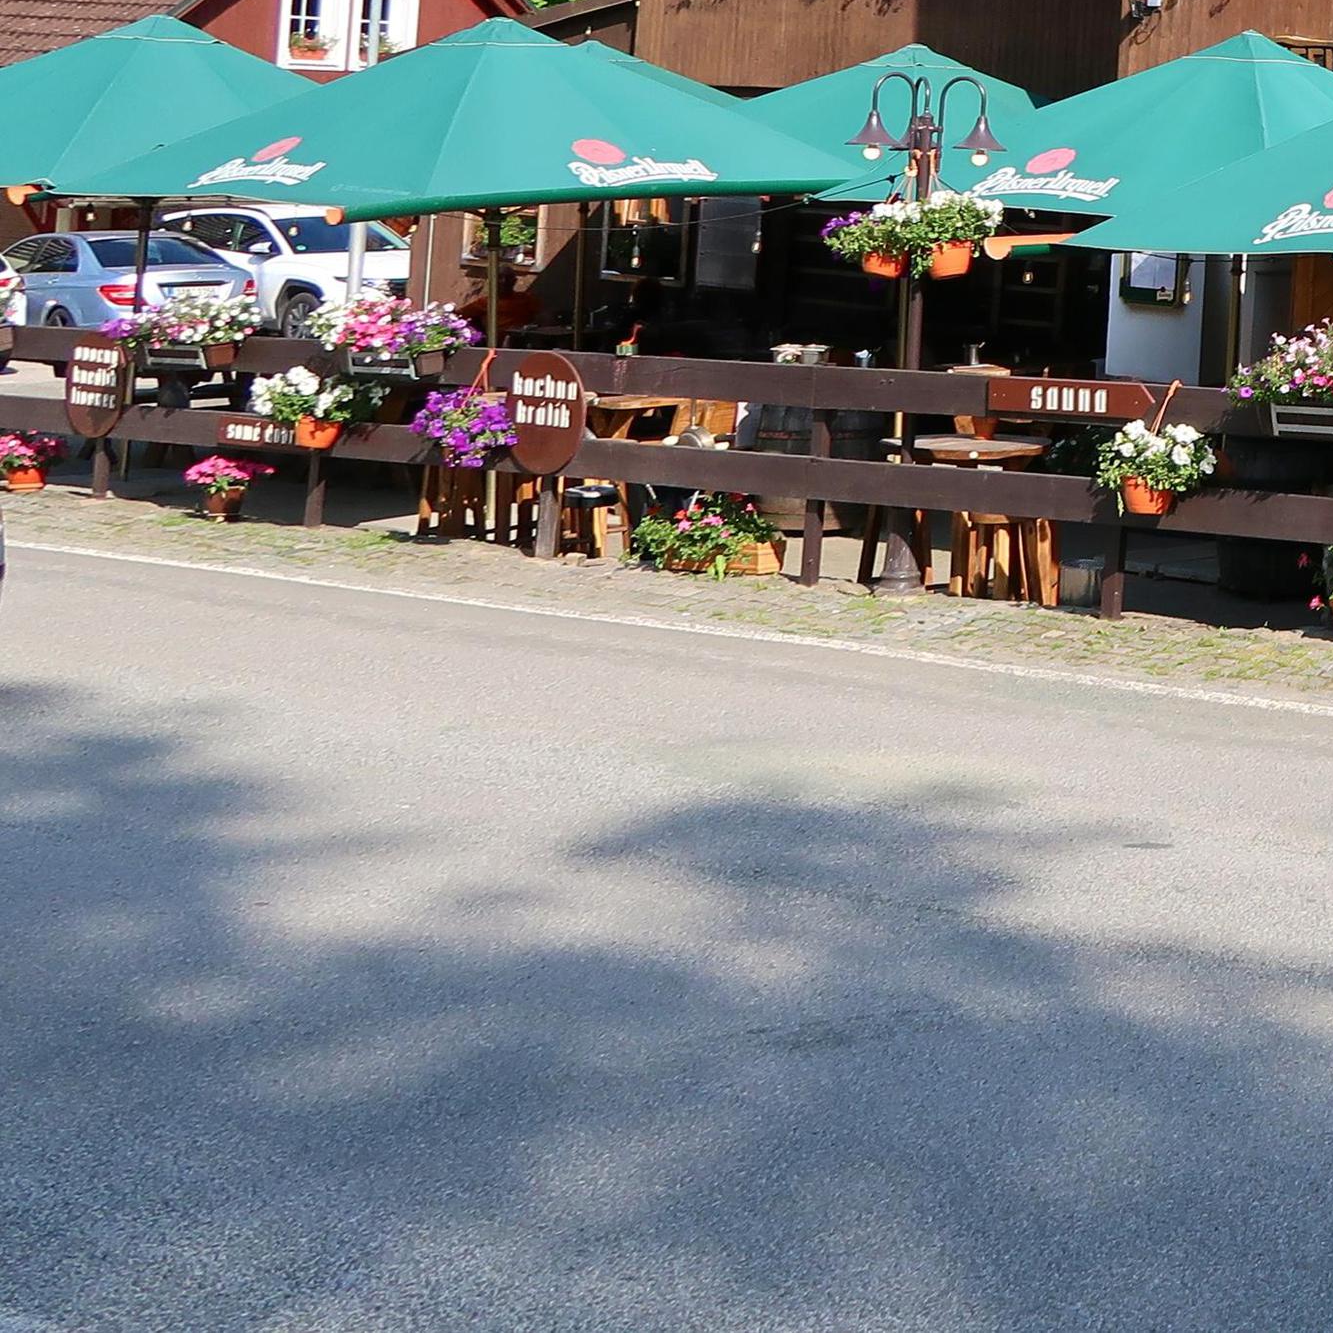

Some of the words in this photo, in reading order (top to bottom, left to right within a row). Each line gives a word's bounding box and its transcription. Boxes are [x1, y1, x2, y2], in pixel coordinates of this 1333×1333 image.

[963, 167, 1057, 197] Pilsner
[512, 371, 578, 401] kachna
[1030, 385, 1108, 414] sauna
[515, 399, 571, 429] králík
[226, 422, 262, 442] samé
